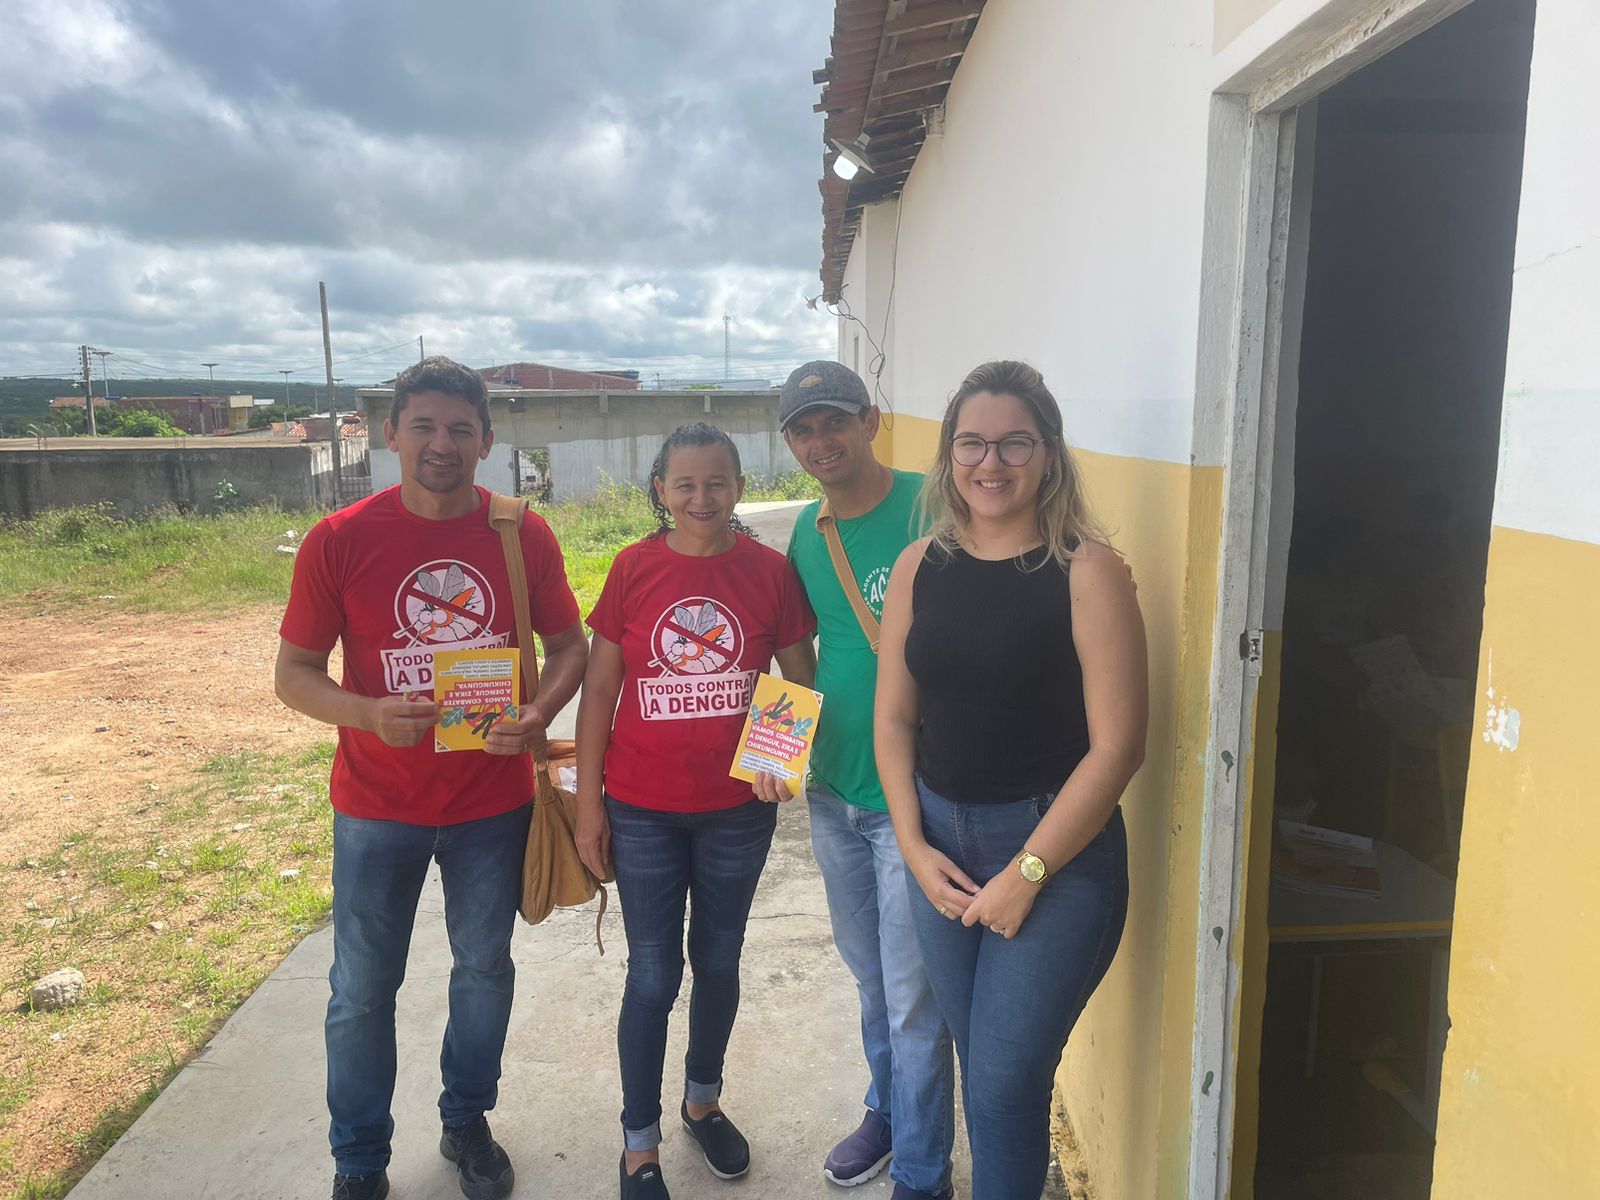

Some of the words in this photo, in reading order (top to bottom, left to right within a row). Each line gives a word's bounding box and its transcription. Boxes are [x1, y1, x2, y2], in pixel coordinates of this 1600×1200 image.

[870, 573, 889, 603] AC
[393, 653, 434, 668] TODO
[396, 670, 411, 687] A
[647, 683, 692, 696] TODOS
[696, 678, 750, 693] CONTRA
[443, 698, 482, 706] COMBATER
[484, 696, 512, 704] VAMOS
[650, 699, 662, 714] A
[668, 690, 750, 714] DENGUE
[752, 724, 774, 736] VAMOS
[776, 732, 805, 747] COMBATER
